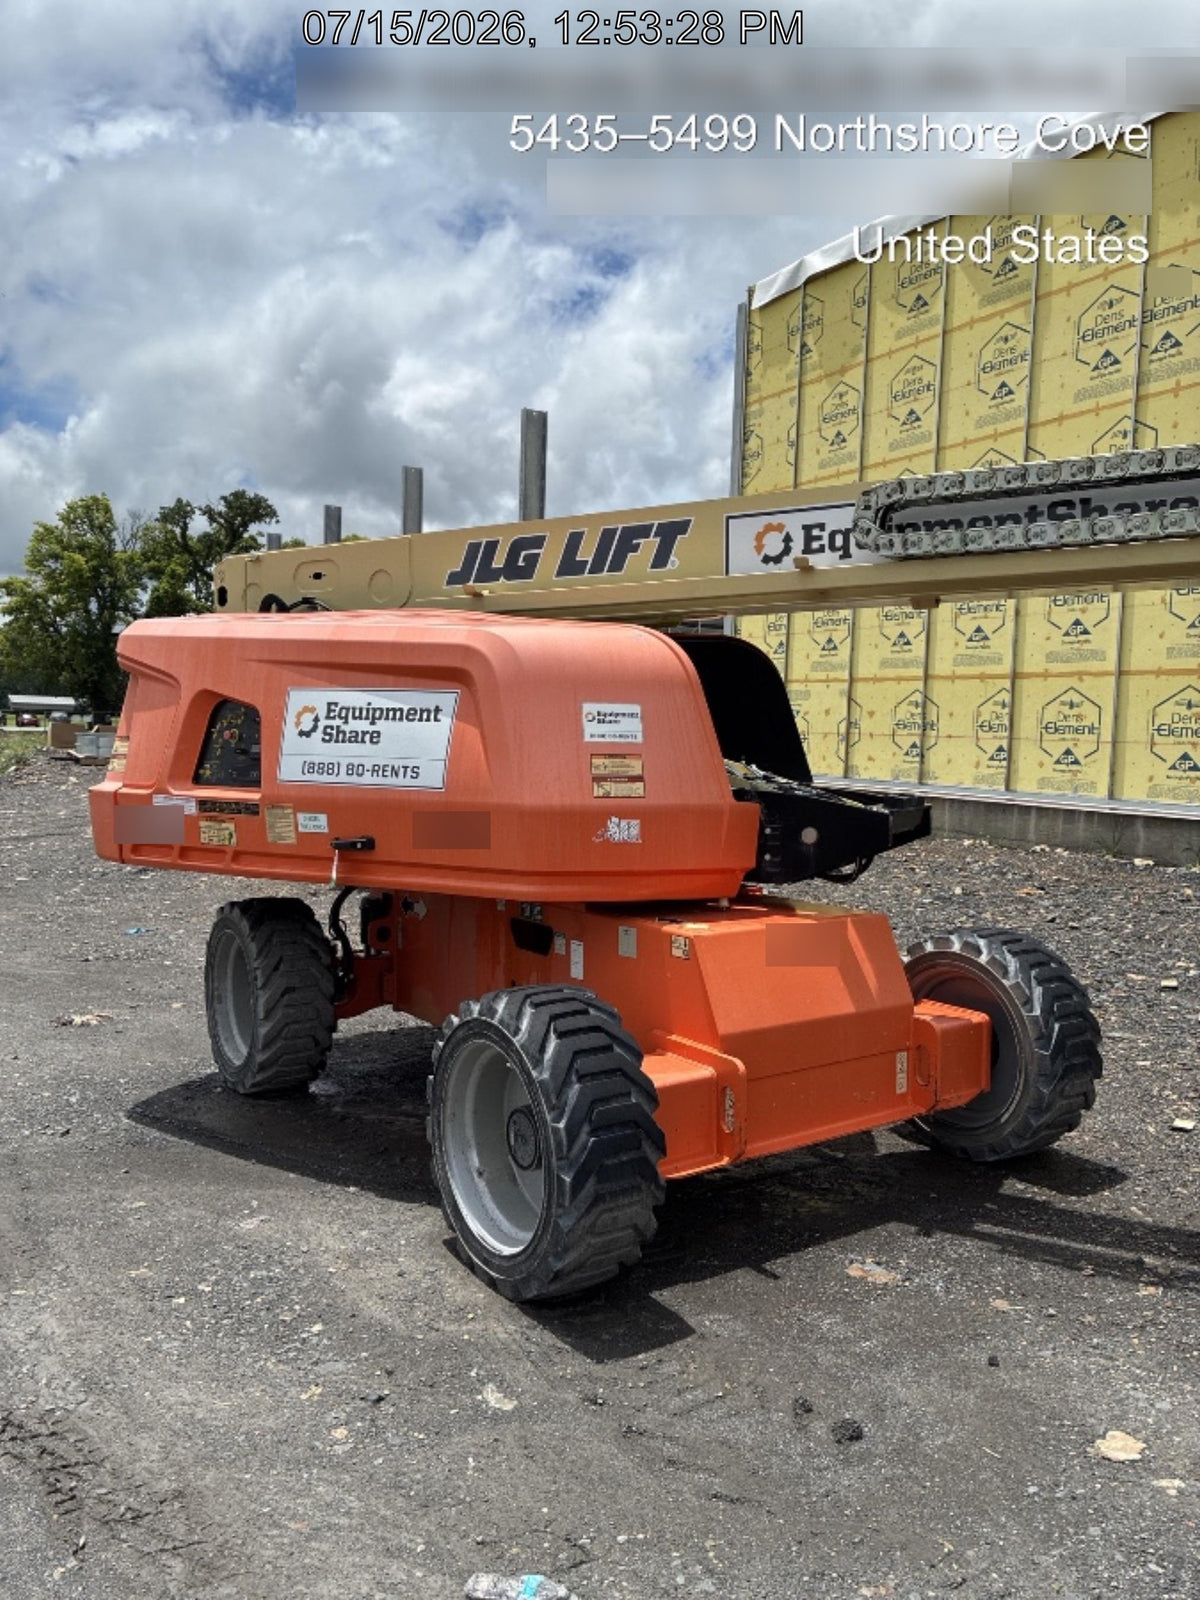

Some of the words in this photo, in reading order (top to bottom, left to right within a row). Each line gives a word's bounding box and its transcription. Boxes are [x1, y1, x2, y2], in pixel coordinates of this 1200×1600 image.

[1094, 308, 1125, 328] Dens
[443, 532, 550, 588] JLG
[1068, 625, 1084, 636] GP
[325, 701, 443, 726] Equipment
[321, 724, 382, 746] Share
[1041, 721, 1100, 735] Element
[1059, 755, 1075, 764] GP
[1174, 760, 1195, 771] GP
[301, 760, 341, 777] (888)
